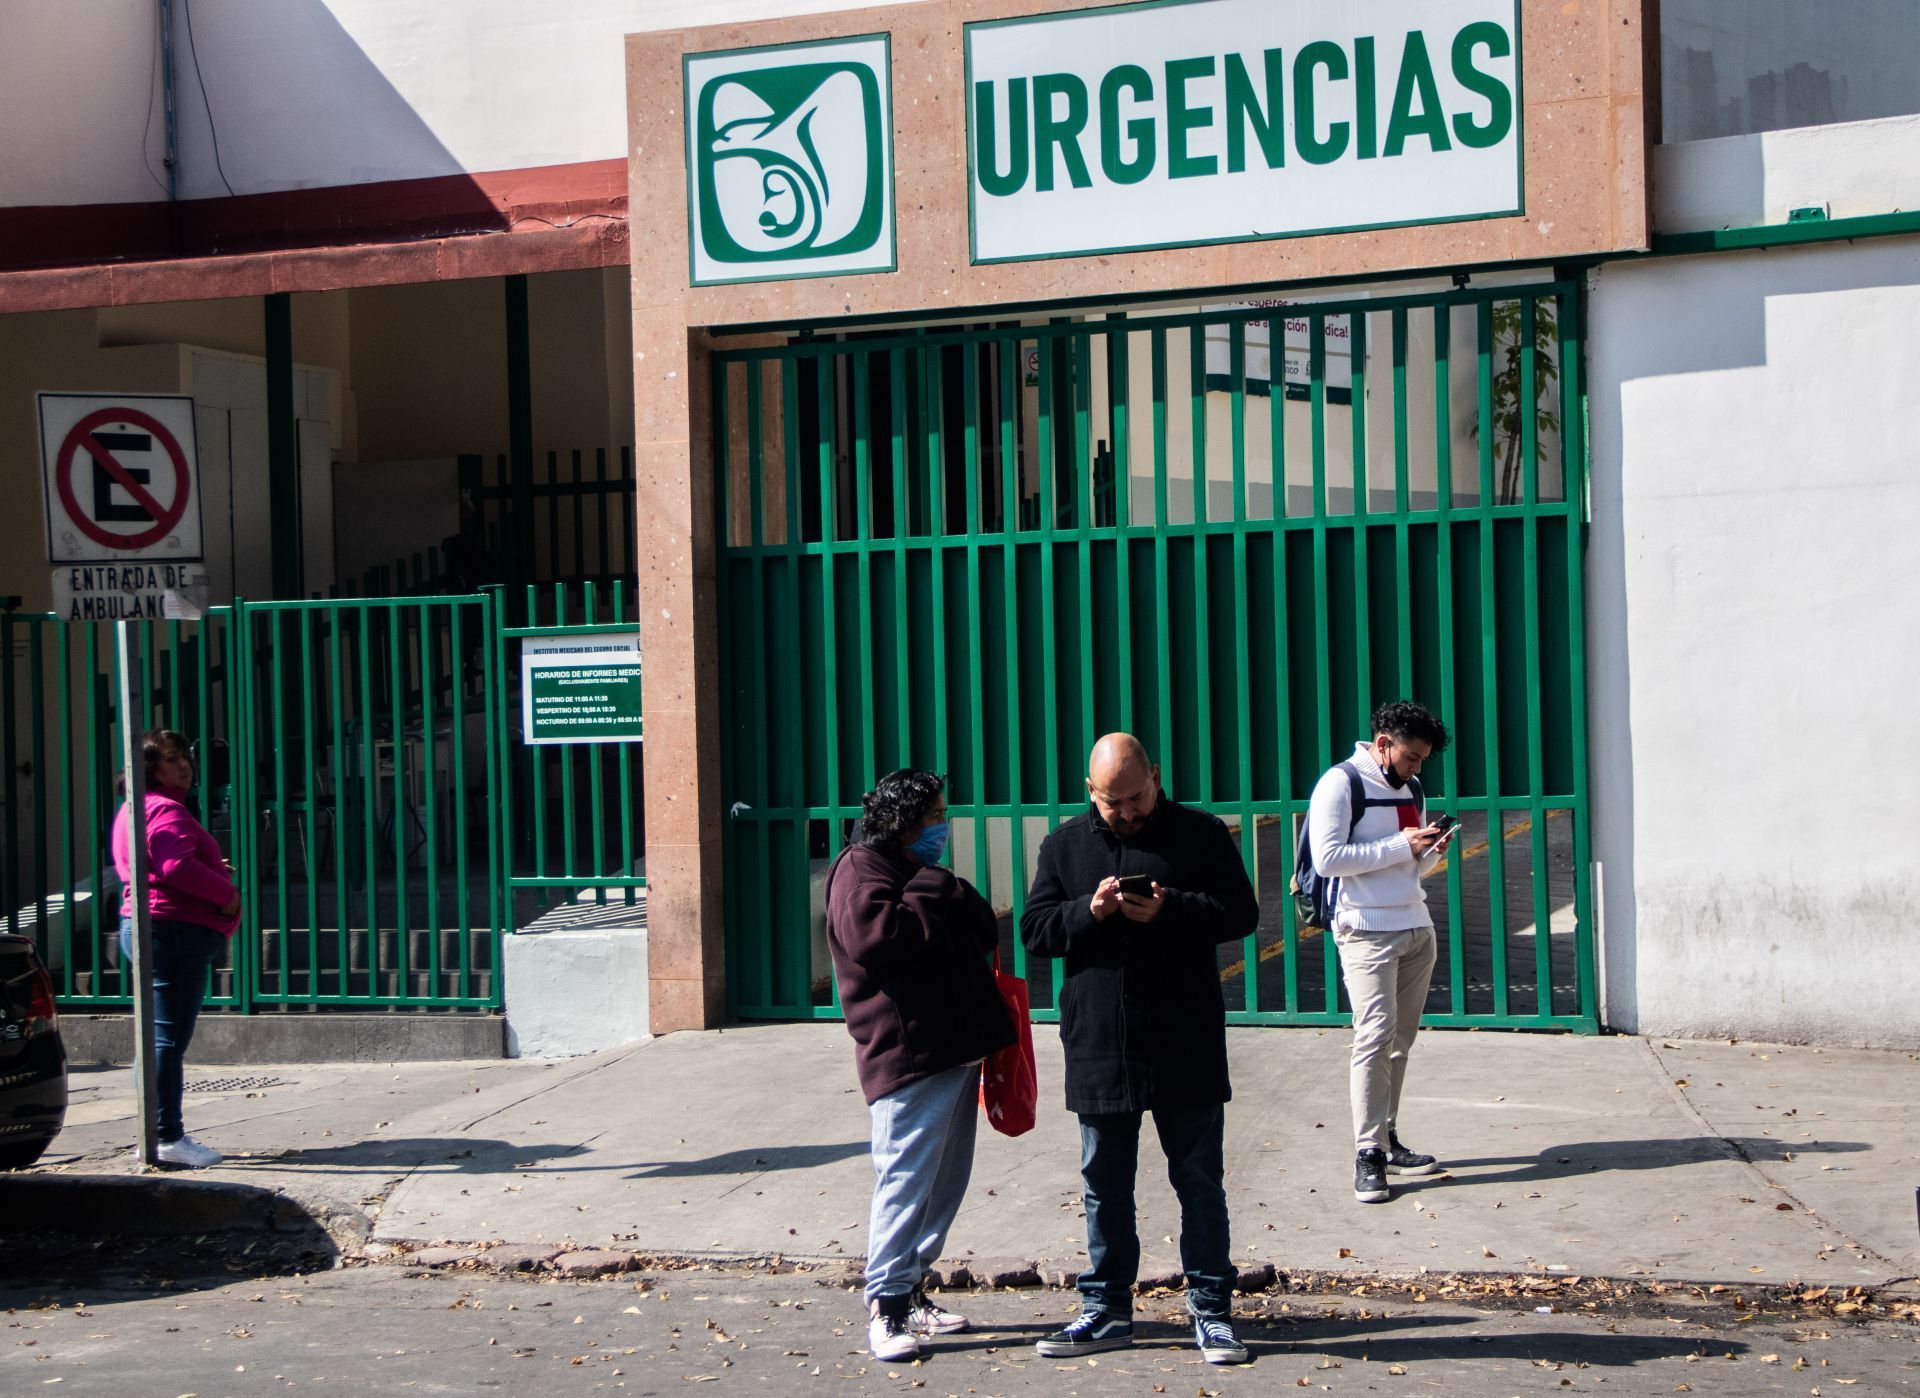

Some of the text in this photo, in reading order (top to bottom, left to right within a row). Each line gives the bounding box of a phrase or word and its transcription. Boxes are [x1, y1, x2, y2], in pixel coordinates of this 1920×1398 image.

[975, 21, 1512, 197] URGENCIAS
[1325, 324, 1348, 338] dica!
[72, 566, 187, 591] ENTRADA DE
[534, 668, 641, 679] HORARIOS DE INFORMES MEDIC
[535, 696, 565, 704] MATUTINO
[594, 694, 609, 702] 11:30
